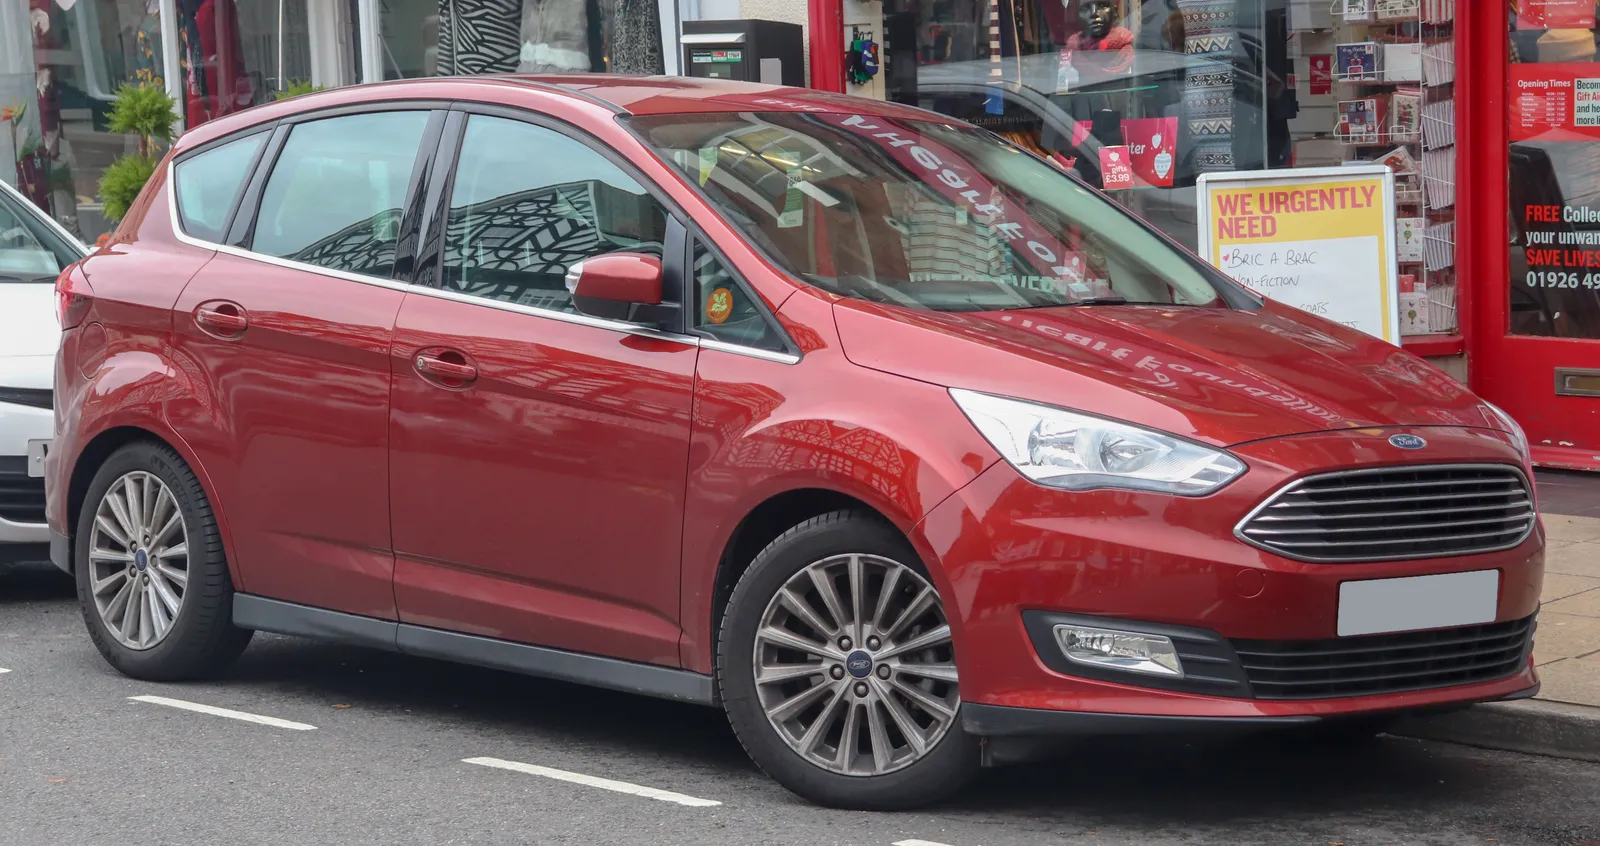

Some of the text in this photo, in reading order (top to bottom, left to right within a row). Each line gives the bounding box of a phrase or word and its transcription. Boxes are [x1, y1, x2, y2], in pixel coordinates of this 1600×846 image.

[1518, 79, 1571, 89] Opening Times
[1576, 92, 1590, 101] Gift
[1576, 104, 1590, 113] and
[1106, 173, 1129, 183] £3.99
[1217, 185, 1377, 216] WE URGENTLY
[1525, 205, 1560, 222] FREE
[1218, 215, 1276, 239] NEED
[1526, 231, 1600, 247] your unwan
[1228, 248, 1318, 268] BRIC A BRAC
[1526, 248, 1600, 267] SAVE LIVES
[1526, 271, 1600, 289] 01926 49
